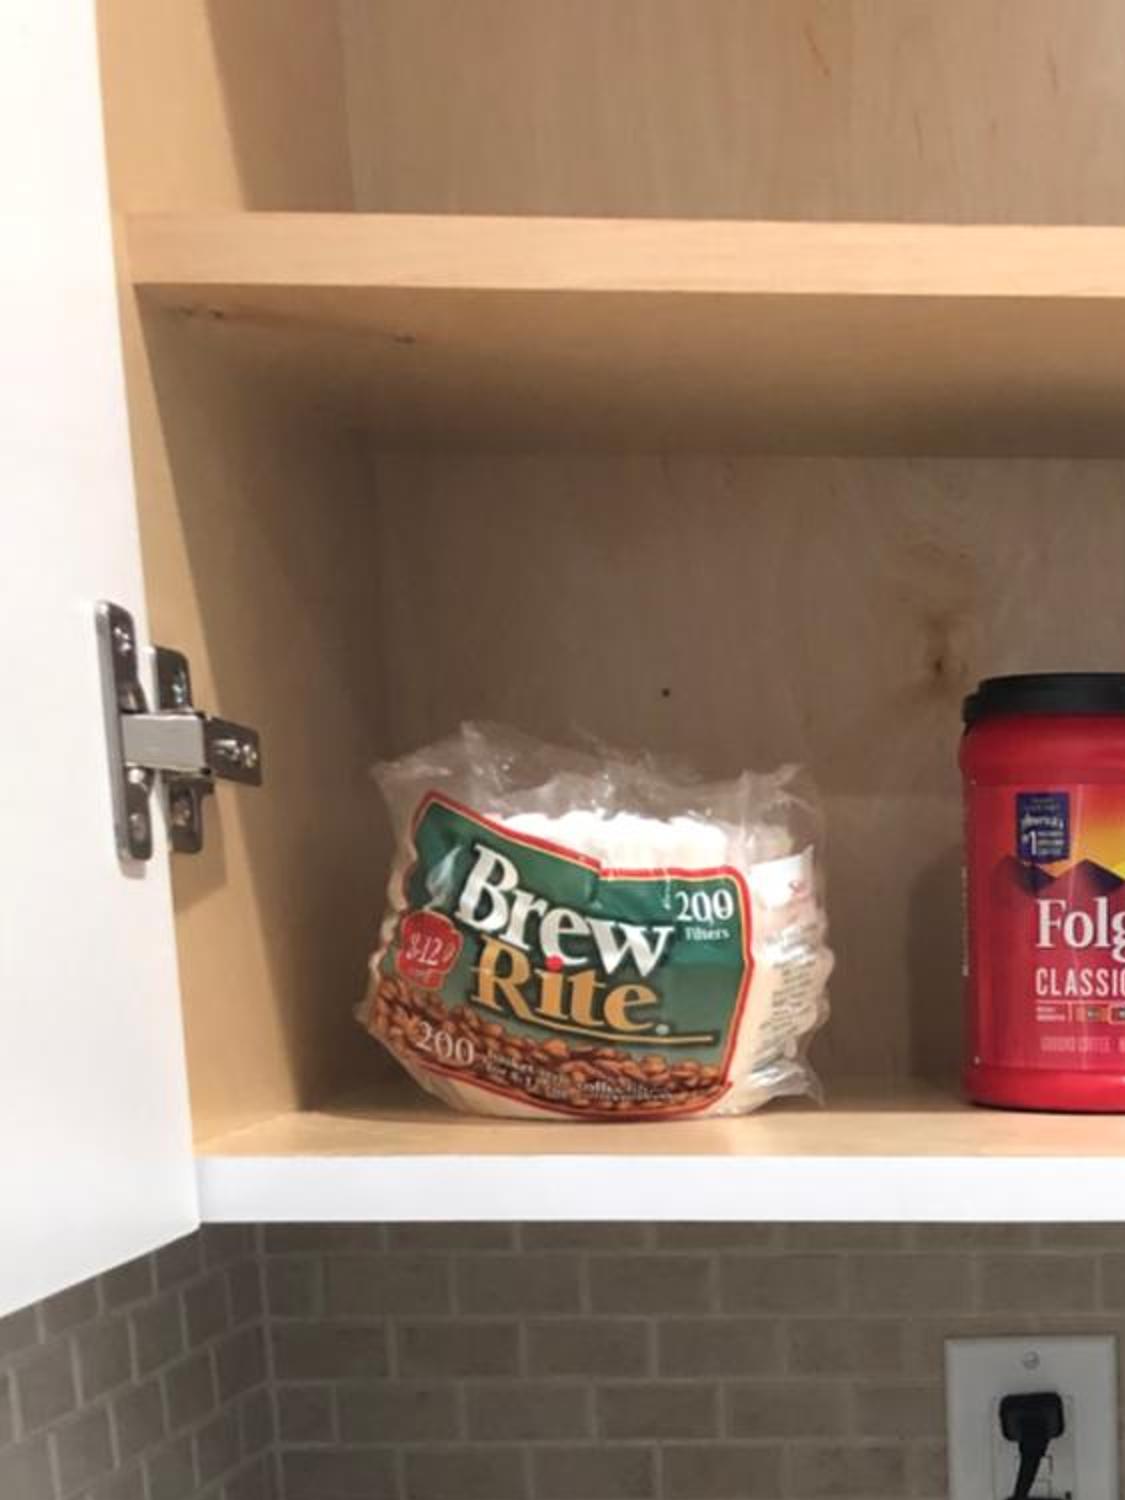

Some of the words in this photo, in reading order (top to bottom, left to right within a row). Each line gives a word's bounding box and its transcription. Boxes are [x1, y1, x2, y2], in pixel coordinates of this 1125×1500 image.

[456, 843, 674, 978] Brew
[675, 888, 734, 922] 200
[415, 1020, 475, 1066] 200
